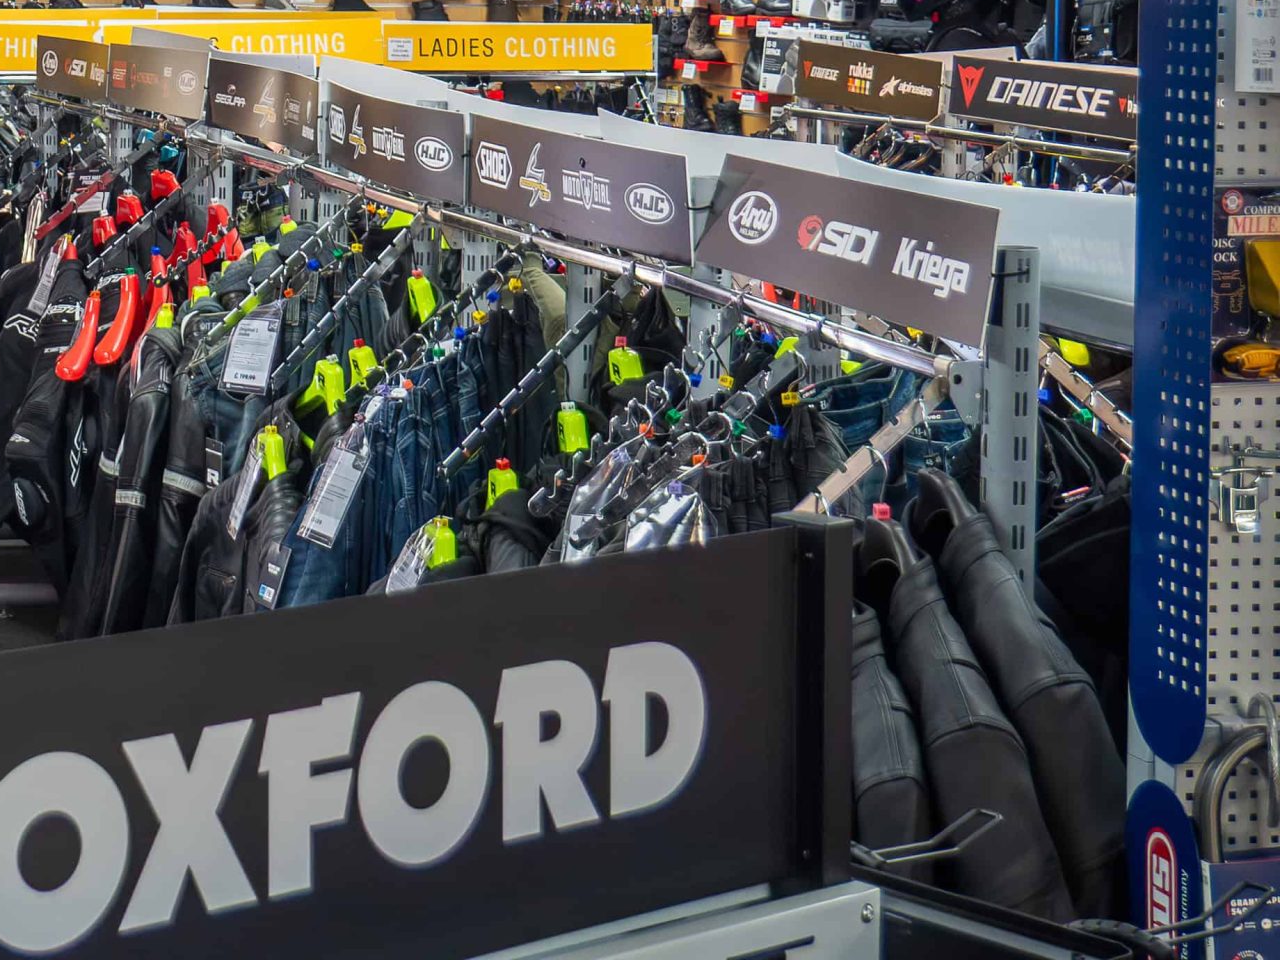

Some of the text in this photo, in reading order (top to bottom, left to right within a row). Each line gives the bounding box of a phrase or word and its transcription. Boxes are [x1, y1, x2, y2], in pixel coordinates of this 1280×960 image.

[232, 32, 346, 55] CLOTHING
[418, 36, 494, 58] LADIES
[505, 36, 616, 58] CLOTHING
[849, 62, 874, 80] rukka
[986, 76, 1115, 117] DAINESE
[421, 145, 447, 162] HJC
[481, 148, 507, 183] SHOEI
[562, 174, 582, 197] MOTO
[593, 182, 611, 206] GIRL
[632, 191, 666, 215] HJC
[731, 195, 970, 299] Arai SIDI Kriega
[1213, 252, 1238, 262] OCK
[1180, 868, 1190, 922] ermany
[1230, 897, 1259, 908] GRAN
